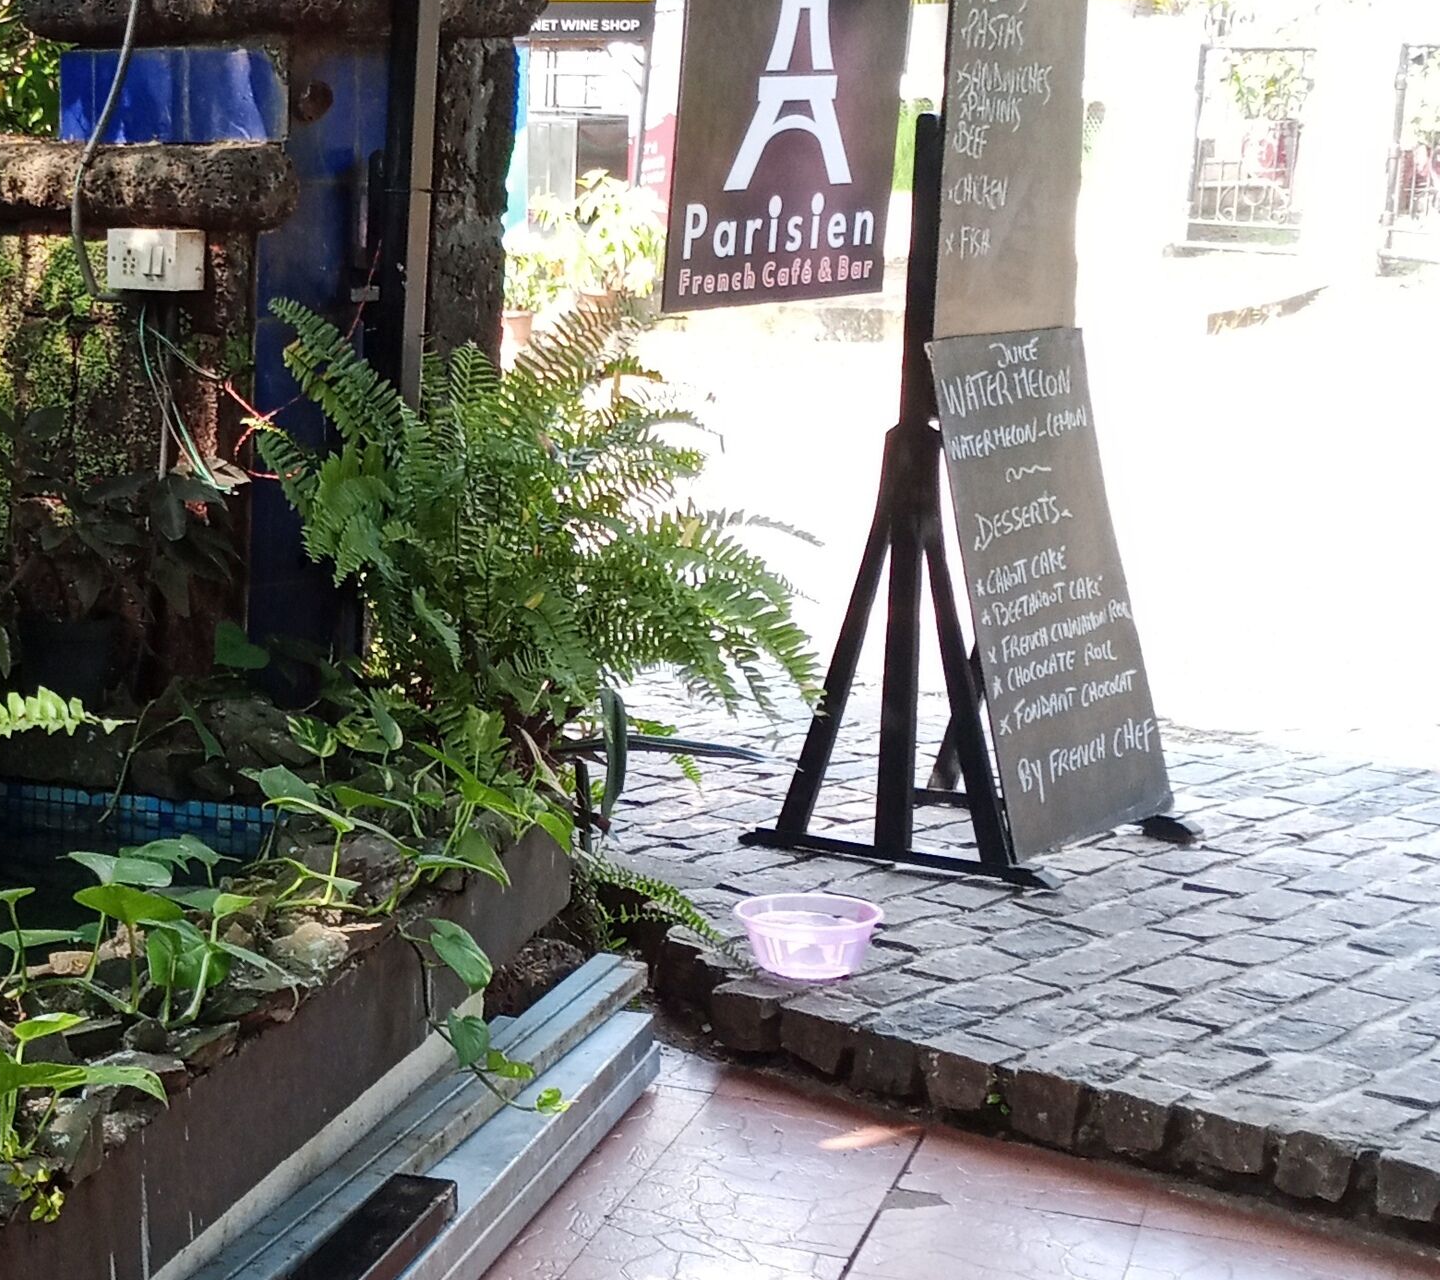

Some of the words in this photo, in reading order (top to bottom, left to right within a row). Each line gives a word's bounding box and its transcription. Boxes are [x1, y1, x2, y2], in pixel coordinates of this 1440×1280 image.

[561, 19, 599, 32] WINE
[601, 19, 640, 32] SHOP
[966, 8, 1025, 54] PASTAS
[682, 192, 875, 260] Parisien
[960, 225, 991, 261] FISH
[678, 262, 756, 296] French
[762, 257, 811, 288] Café
[817, 256, 833, 283] &
[837, 254, 873, 281] Bar
[989, 336, 1040, 368] JUICE
[1031, 545, 1067, 579] CAKE
[1069, 574, 1103, 601] CAKE
[1001, 627, 1049, 663] FRENCH
[1007, 650, 1076, 692] CHOCOLATE
[1084, 640, 1118, 666] ROLL
[1013, 686, 1077, 730] FONDANT
[1080, 669, 1137, 707] CHOCOLAT
[1049, 733, 1106, 784] FRENCH
[1113, 718, 1156, 758] CHEF
